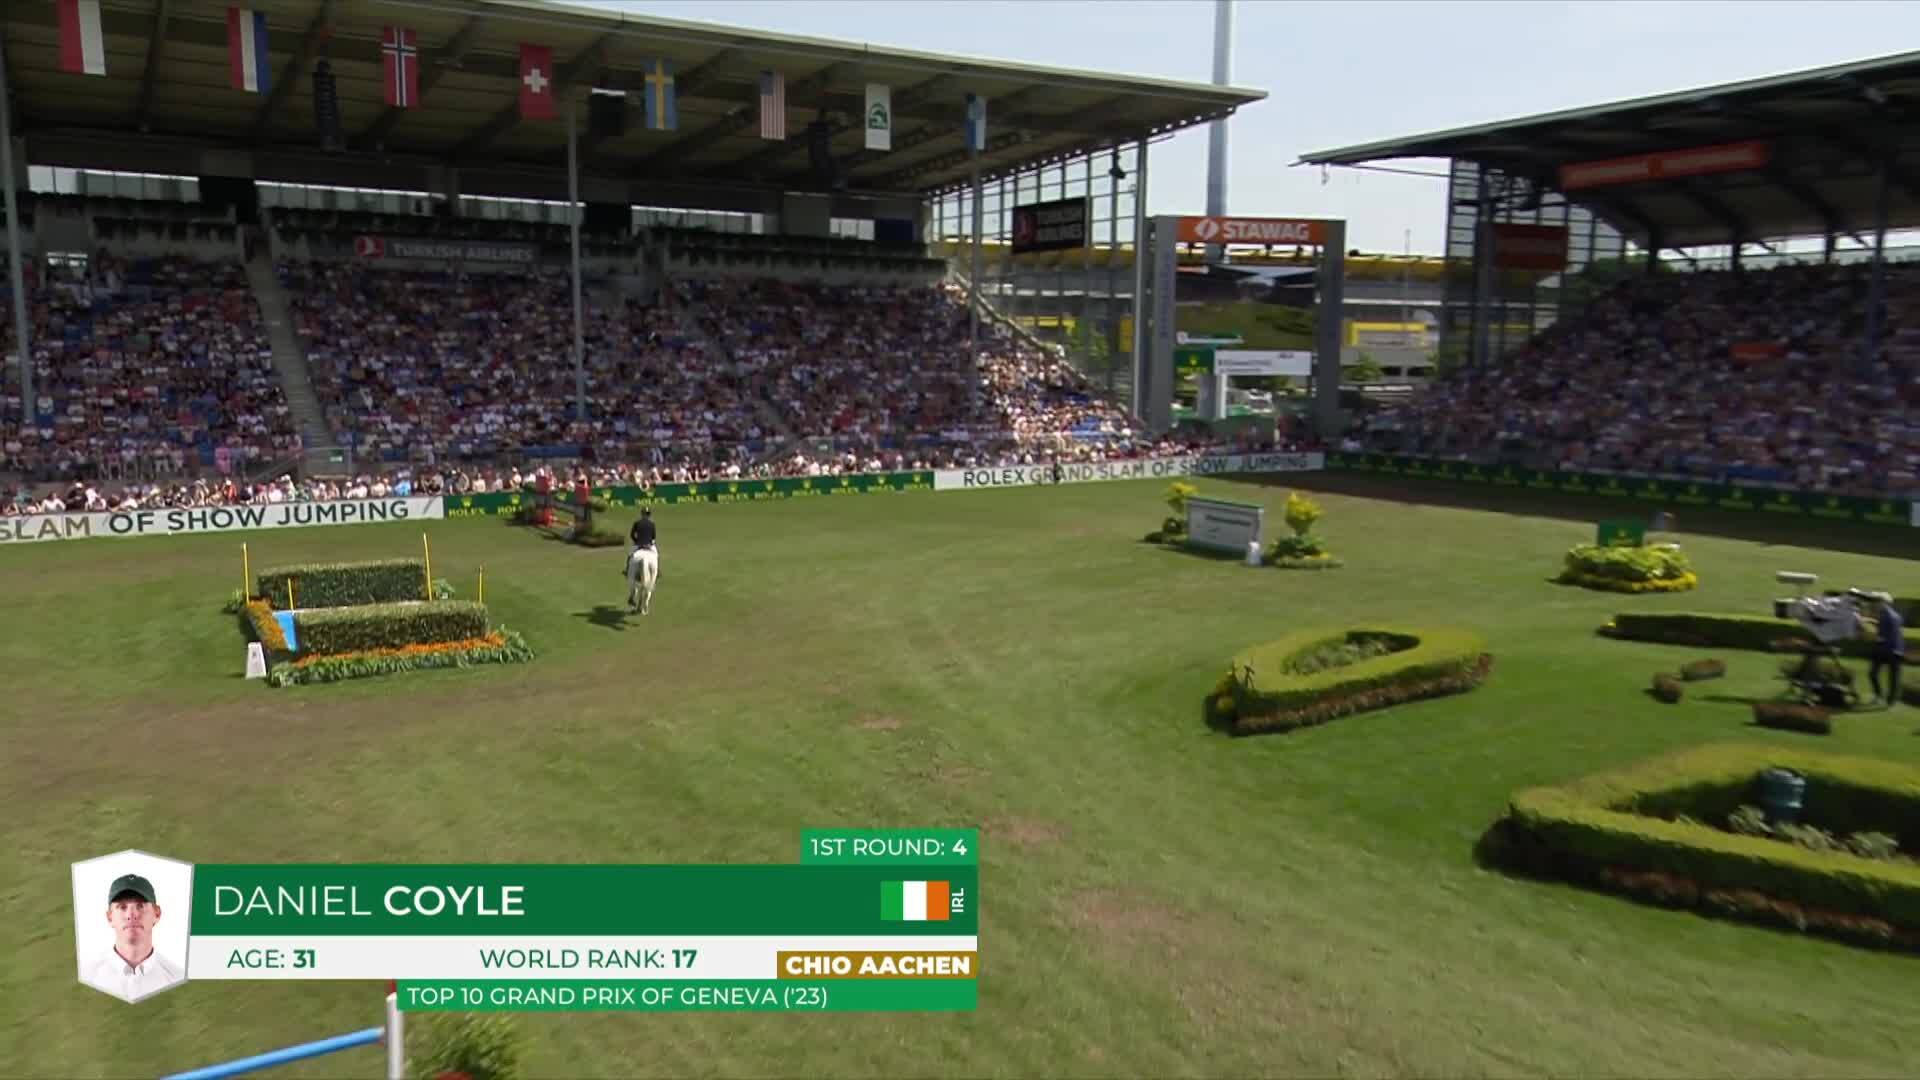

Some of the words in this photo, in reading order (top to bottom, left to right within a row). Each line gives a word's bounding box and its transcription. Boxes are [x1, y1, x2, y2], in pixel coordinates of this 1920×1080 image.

[1223, 221, 1310, 240] STAWAG
[963, 469, 1025, 487] ROLEX
[1029, 466, 1094, 485] GRAND
[1097, 462, 1145, 479] SLAM
[1152, 461, 1175, 475] OF
[1179, 458, 1228, 473] SHOW
[0, 516, 91, 541] SLAM
[109, 513, 154, 534] OF
[167, 505, 266, 531] SHOW
[277, 500, 409, 525] JUMPING
[449, 507, 485, 518] ROLEX
